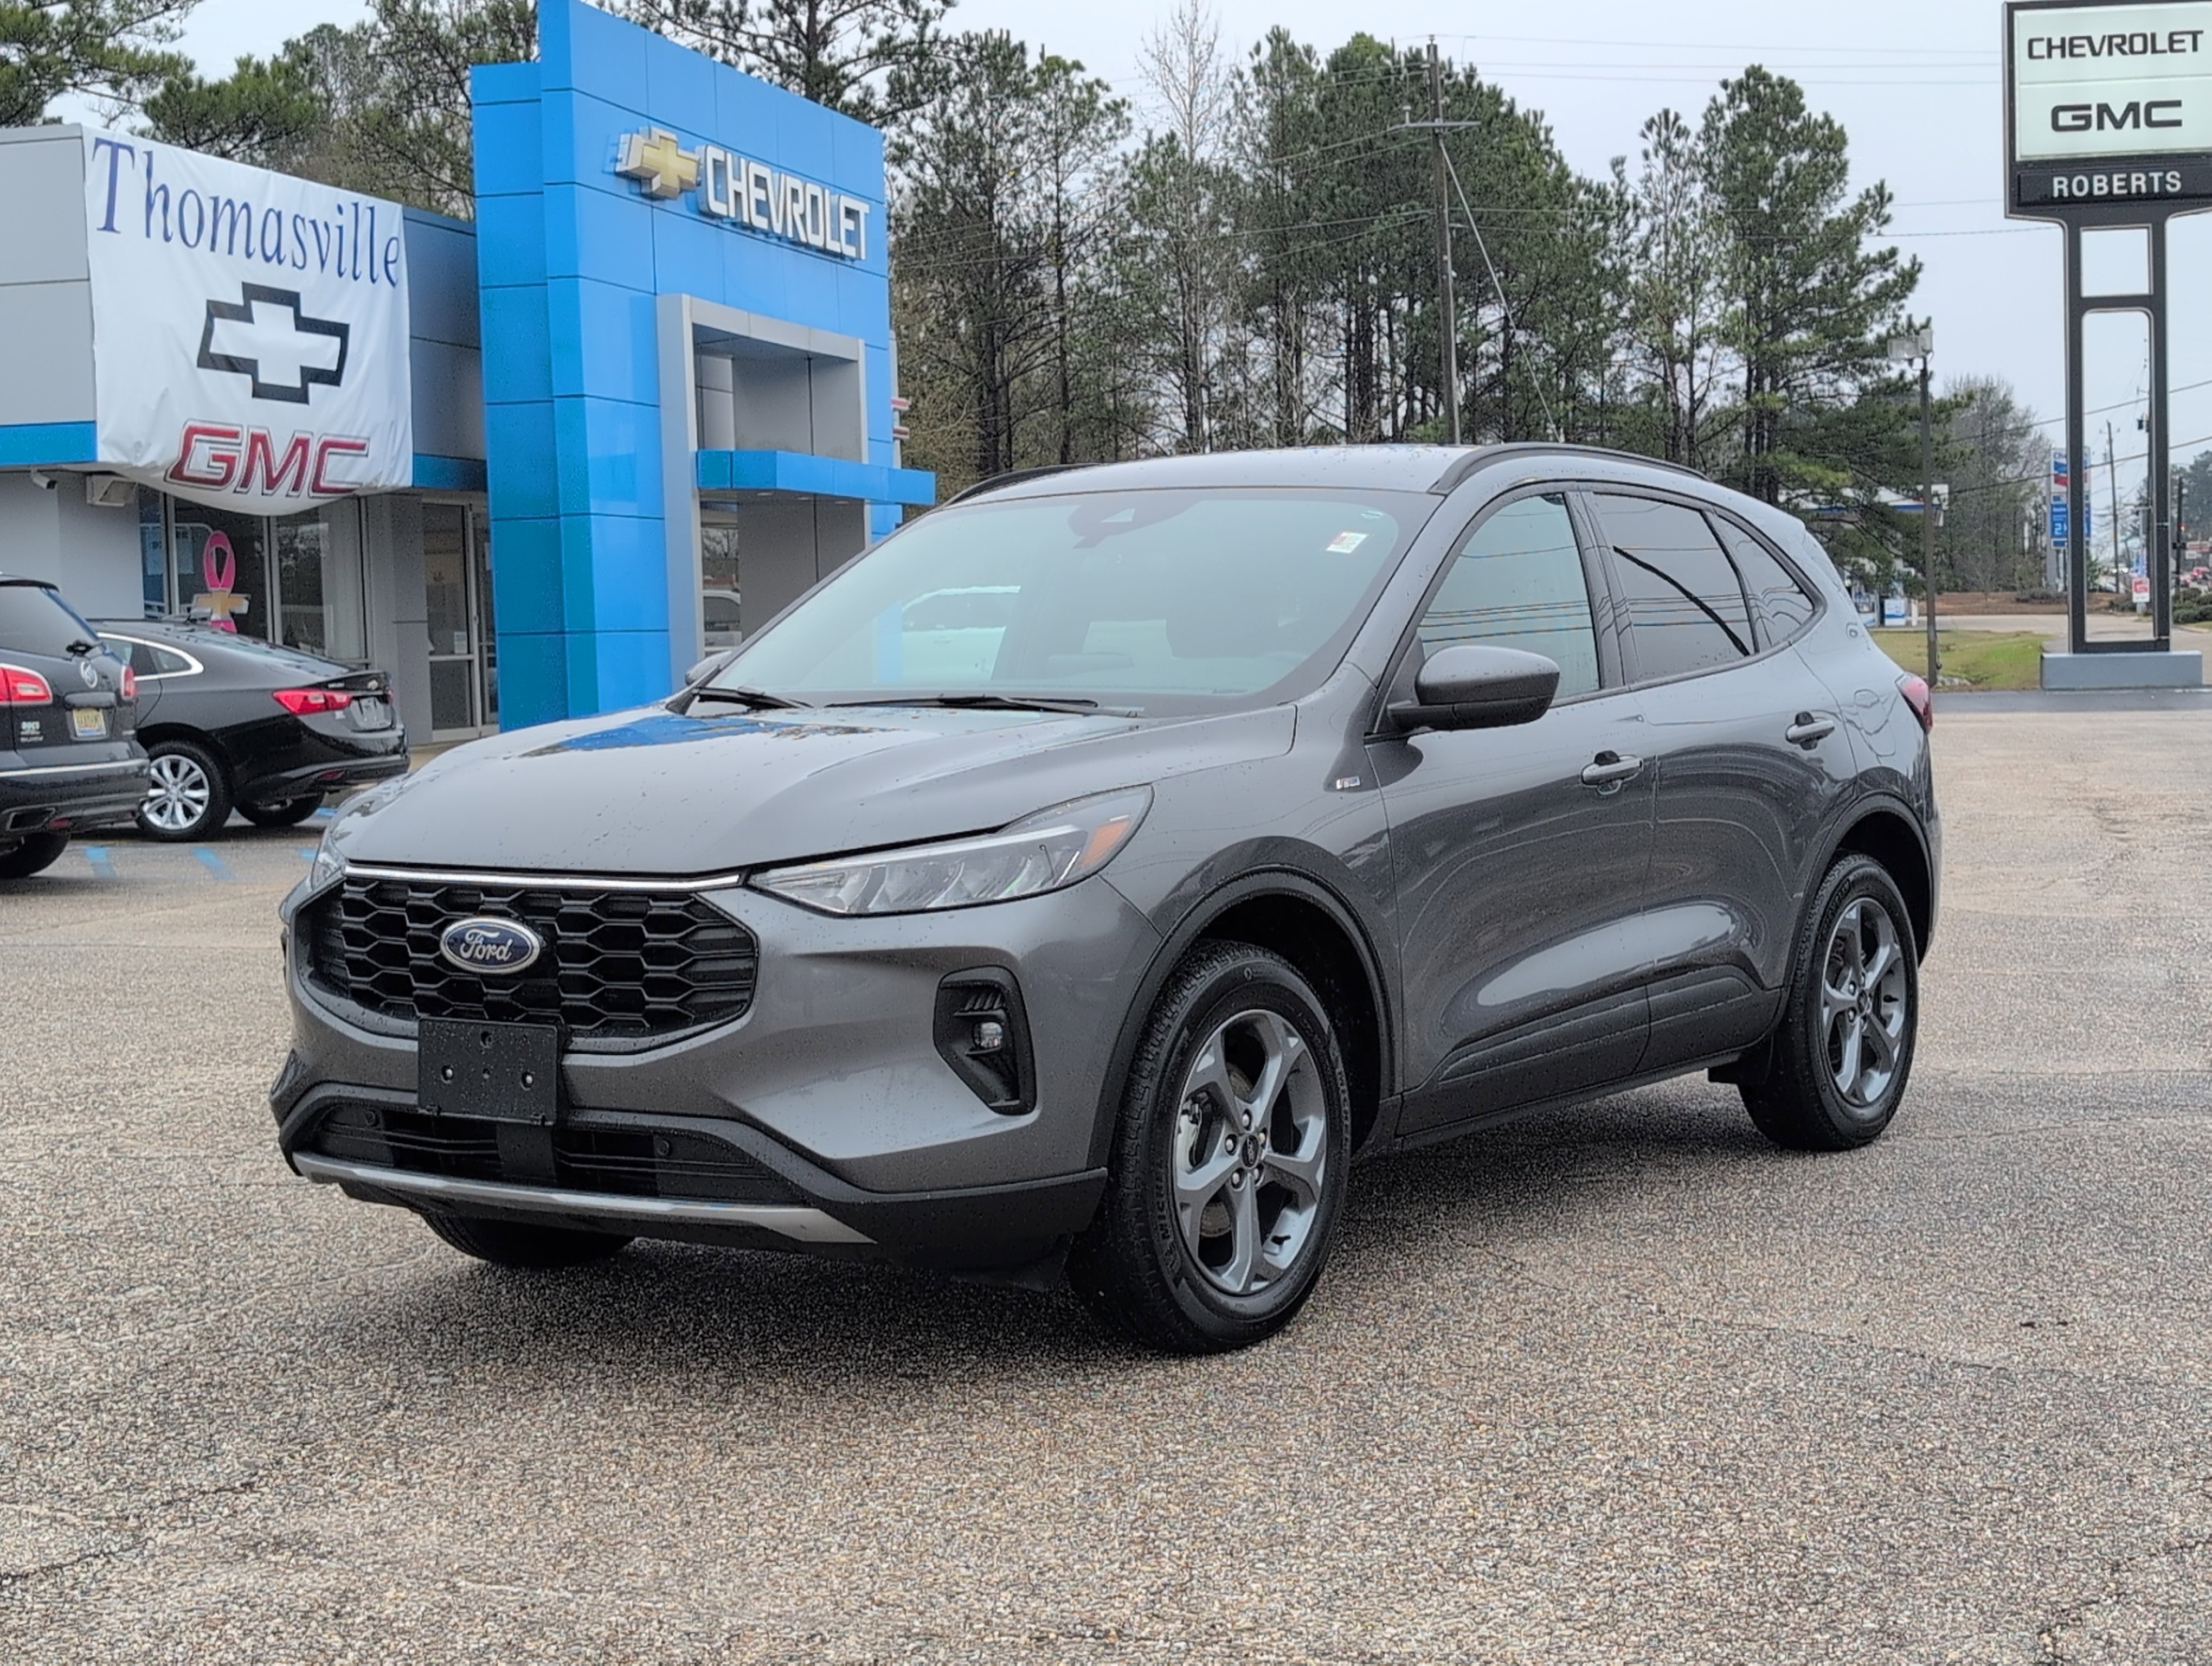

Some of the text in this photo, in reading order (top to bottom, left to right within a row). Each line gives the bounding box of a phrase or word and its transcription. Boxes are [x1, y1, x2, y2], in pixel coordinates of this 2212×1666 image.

[2027, 30, 2204, 60] CHEVROLET
[2051, 100, 2182, 132] GMC
[2053, 171, 2182, 198] ROBERTS
[91, 137, 400, 287] Thomasville
[705, 144, 870, 260] CHEVROLET
[165, 418, 370, 498] GMC
[460, 928, 513, 962] Ford
